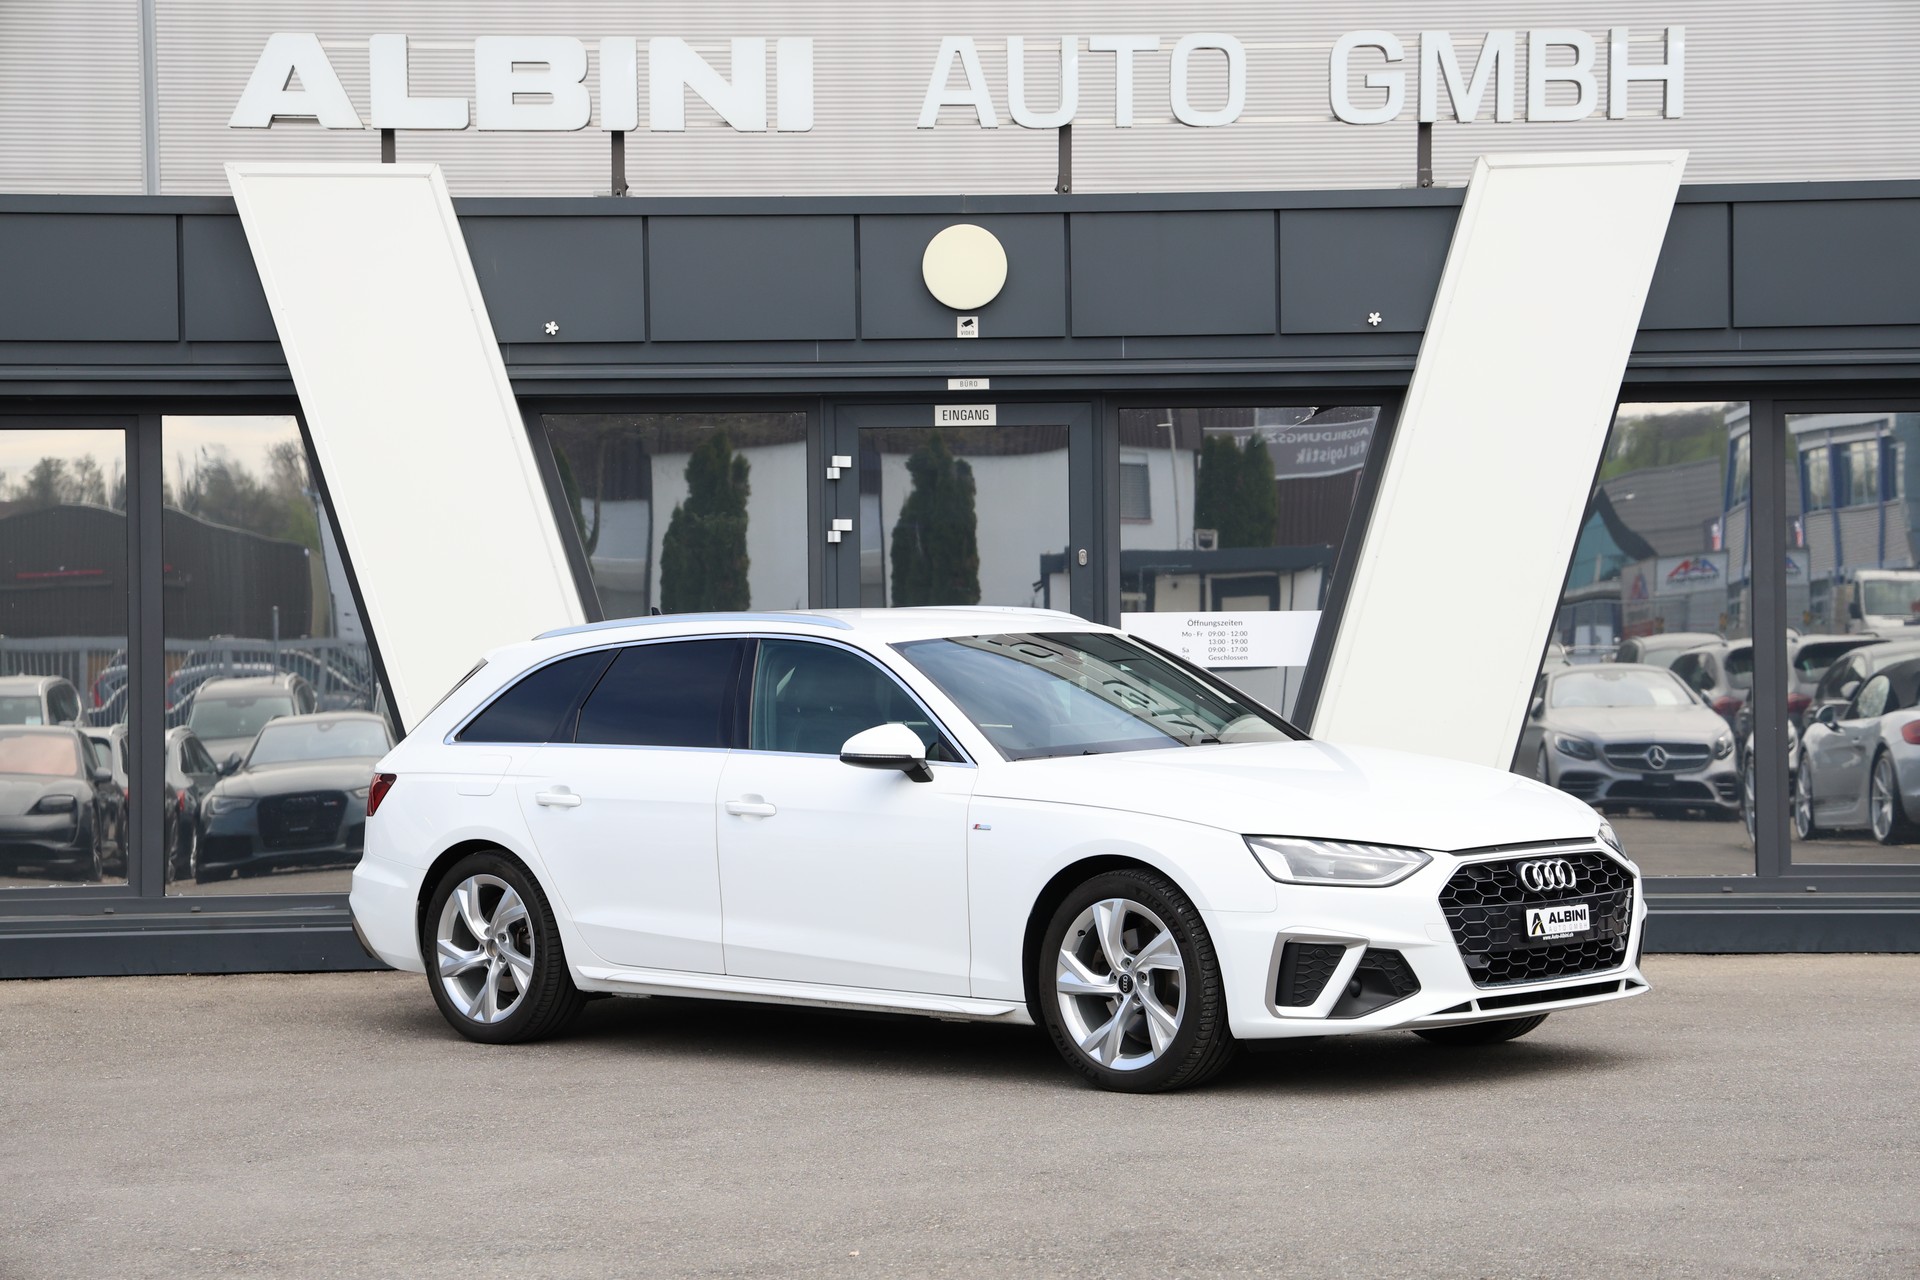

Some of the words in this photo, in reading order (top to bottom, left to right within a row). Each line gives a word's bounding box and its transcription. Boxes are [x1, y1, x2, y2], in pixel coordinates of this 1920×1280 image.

[228, 32, 814, 132] ALBINI
[916, 31, 1246, 130] AUTO
[1329, 25, 1686, 126] GMBH
[959, 379, 978, 388] BÜRO
[942, 409, 990, 421] EINGANG
[1187, 618, 1243, 627] Öffnungszeiten
[1548, 908, 1587, 924] ALBINI
[1549, 924, 1567, 932] AUTO
